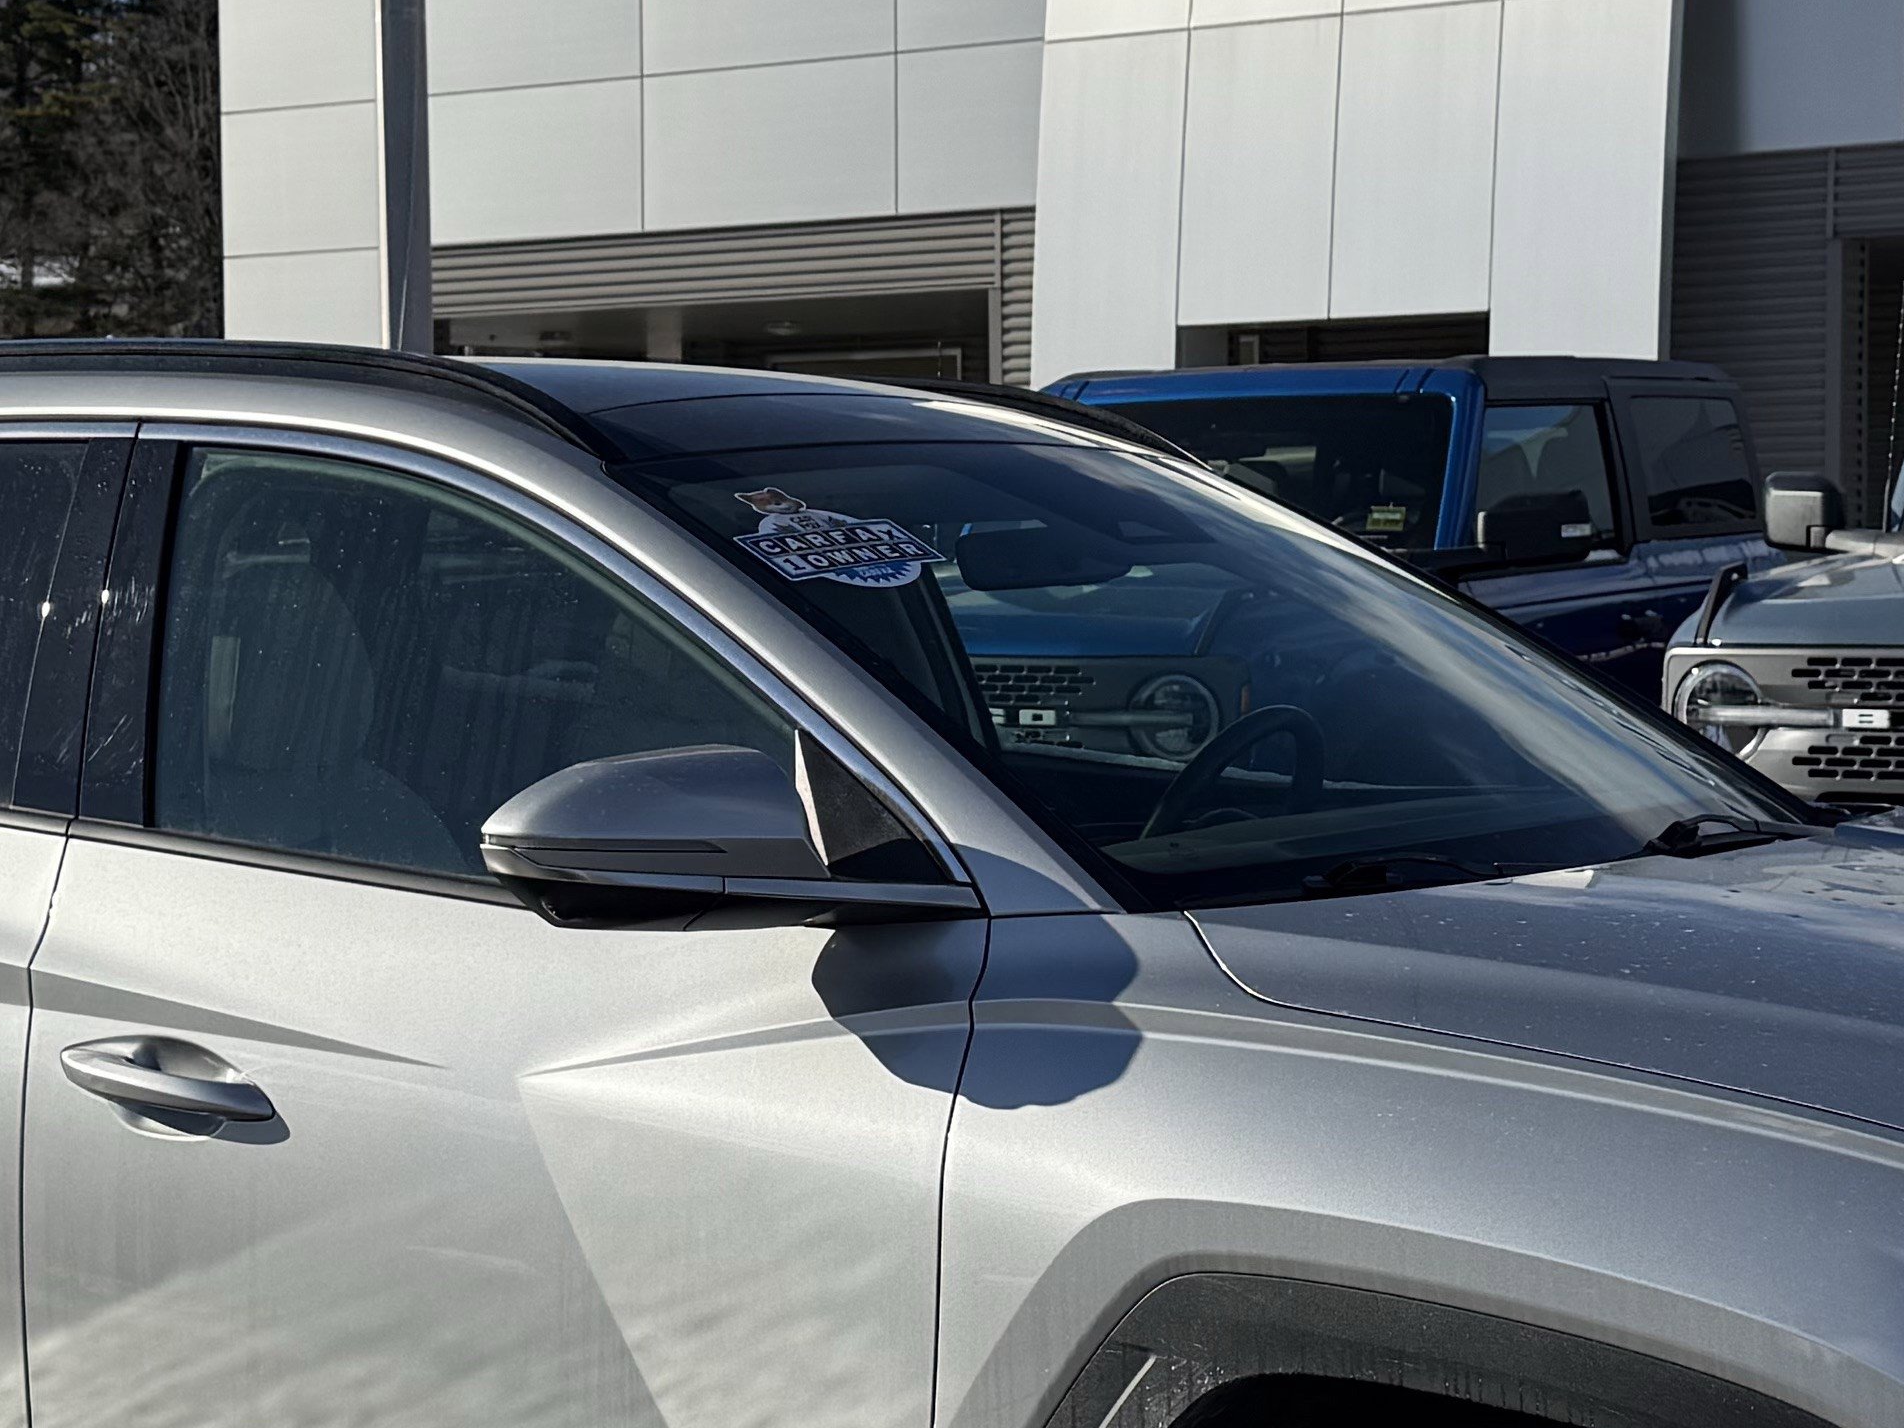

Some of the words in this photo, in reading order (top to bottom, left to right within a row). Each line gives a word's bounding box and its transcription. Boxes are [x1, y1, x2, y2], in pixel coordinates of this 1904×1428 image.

[757, 527, 903, 554] CARFAX
[782, 556, 806, 571] 1
[806, 543, 925, 568] OWNER
